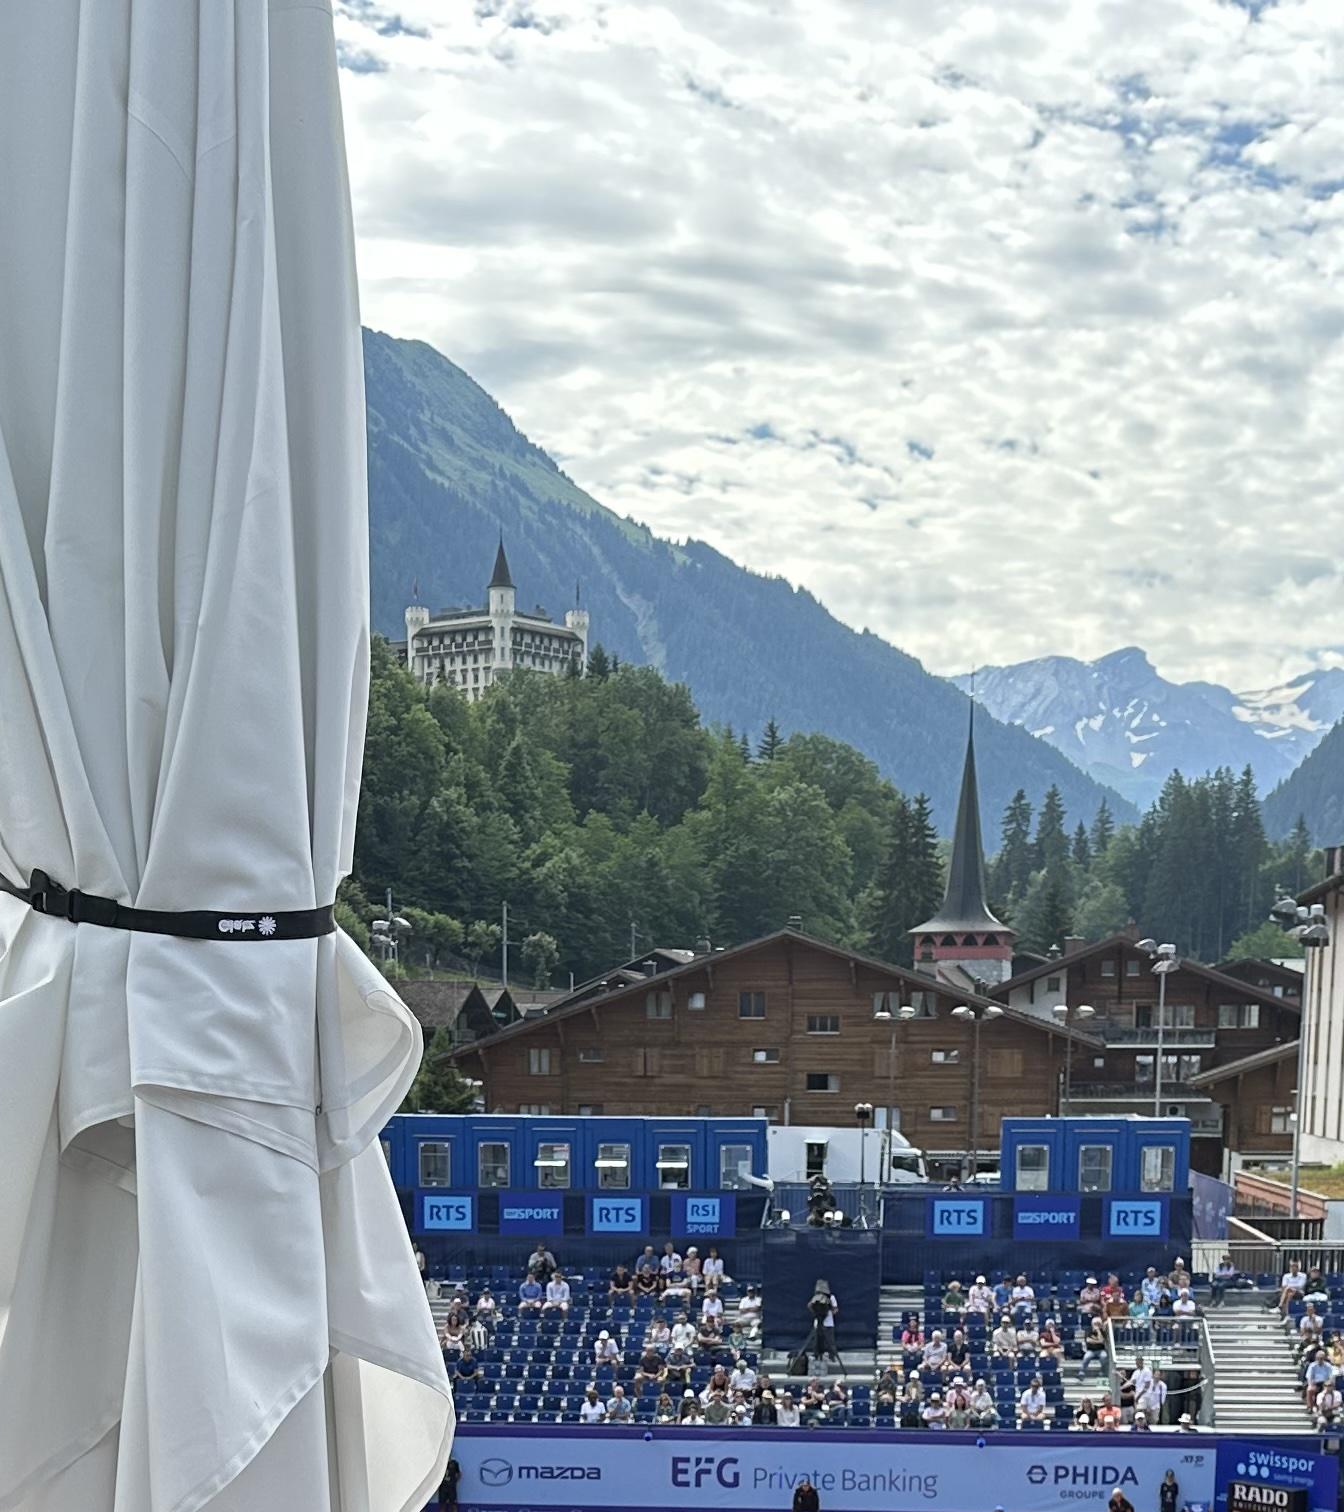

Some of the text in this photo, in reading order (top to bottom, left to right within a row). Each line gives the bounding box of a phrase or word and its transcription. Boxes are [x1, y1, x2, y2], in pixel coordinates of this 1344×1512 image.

[429, 1204, 467, 1222] RTS
[517, 1208, 560, 1220] SPORT
[598, 1208, 636, 1225] RTS
[690, 1203, 717, 1218] RSI
[939, 1208, 978, 1226] RTS
[1032, 1211, 1076, 1224] SPORT
[1115, 1209, 1156, 1227] RTS
[686, 1223, 719, 1234] SPORT
[1249, 1450, 1315, 1473] swisspor
[671, 1456, 741, 1489] EFG
[842, 1467, 939, 1499] Banking
[1054, 1464, 1139, 1486] PHIDA
[1060, 1490, 1105, 1500] GROUPE
[1233, 1483, 1289, 1507] RADO
